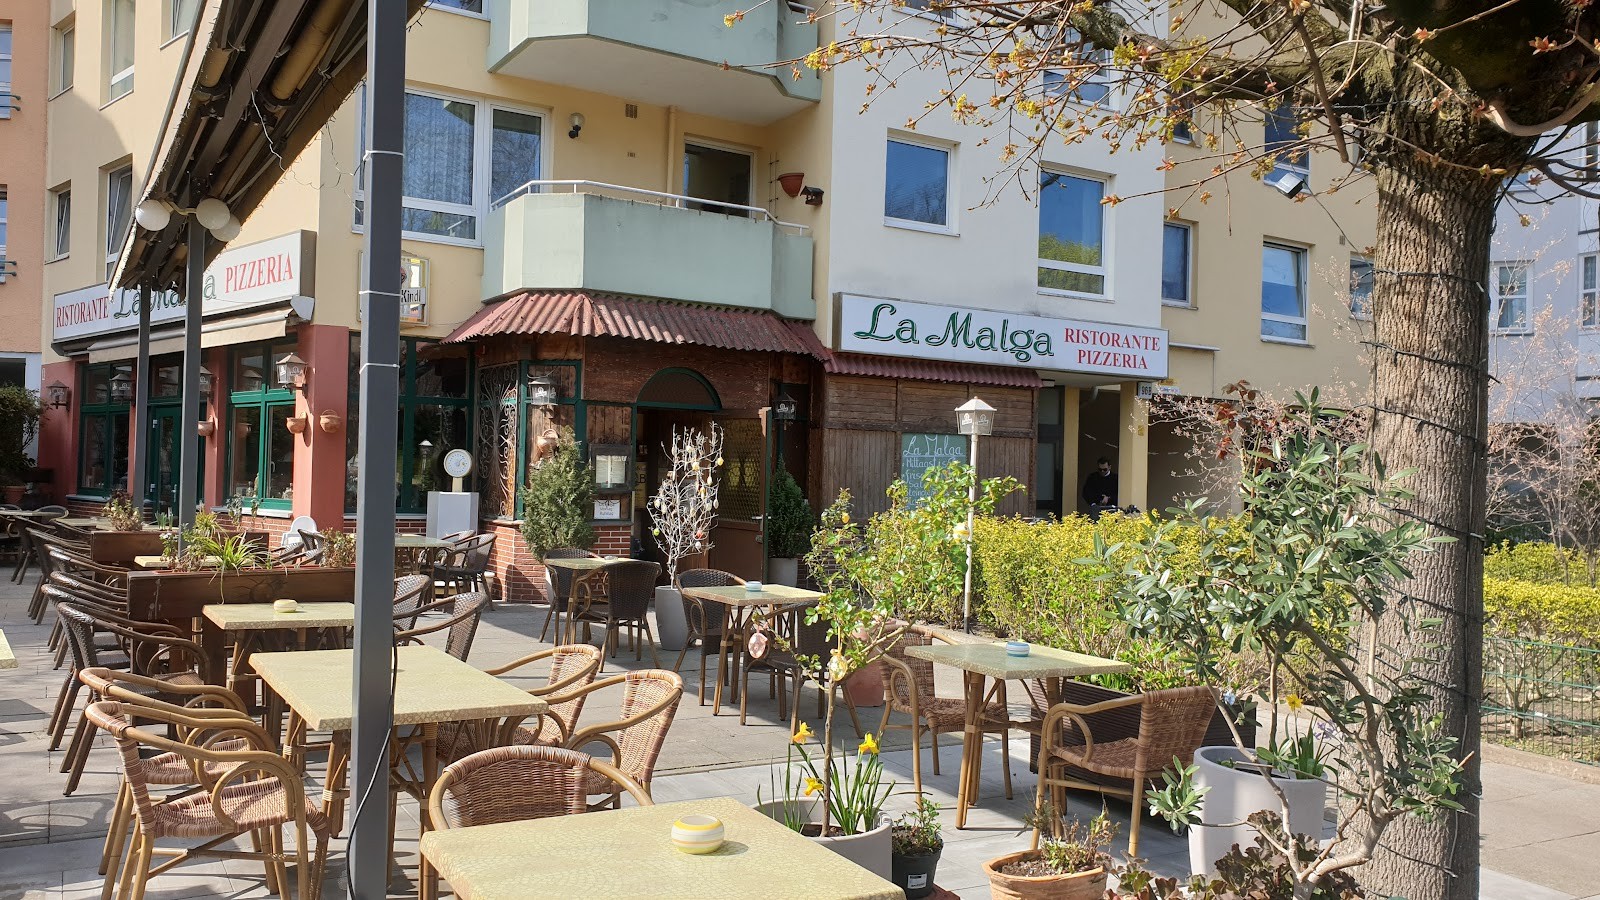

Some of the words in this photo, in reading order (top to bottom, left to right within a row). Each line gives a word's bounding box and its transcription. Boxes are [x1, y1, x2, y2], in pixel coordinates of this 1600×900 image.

[56, 296, 109, 328] RISTORANTE
[225, 251, 294, 294] PIZZERIA
[401, 289, 421, 303] Kindl
[853, 303, 920, 344] La
[925, 311, 1054, 363] Malga
[1064, 327, 1161, 352] RISTORANTE
[1077, 349, 1148, 370] PIZZERIA
[903, 435, 921, 456] La
[925, 434, 964, 456] Malga
